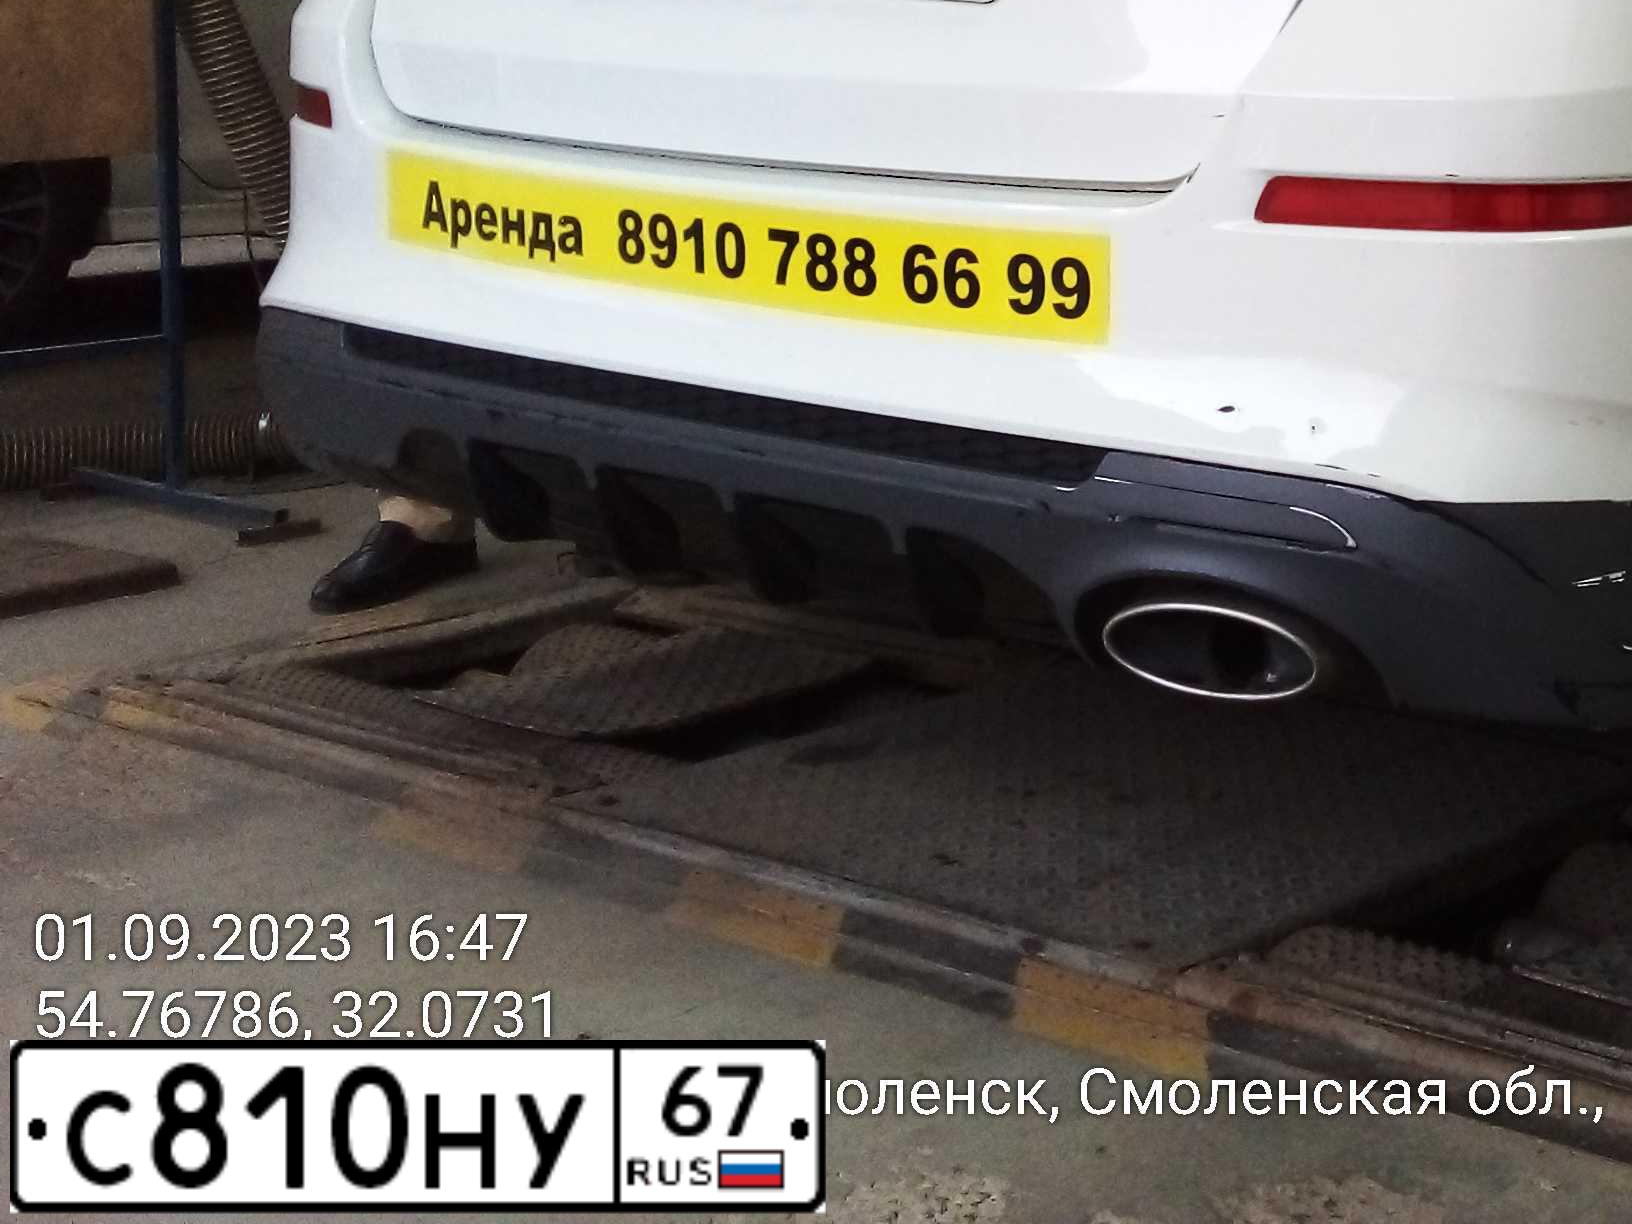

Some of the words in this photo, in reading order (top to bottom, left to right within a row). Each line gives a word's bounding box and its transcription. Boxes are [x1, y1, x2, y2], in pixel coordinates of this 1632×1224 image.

[421, 180, 584, 263] Аренда
[616, 209, 747, 279] 8910
[767, 229, 877, 297] 788
[901, 244, 981, 309] 66
[1007, 253, 1092, 320] 99
